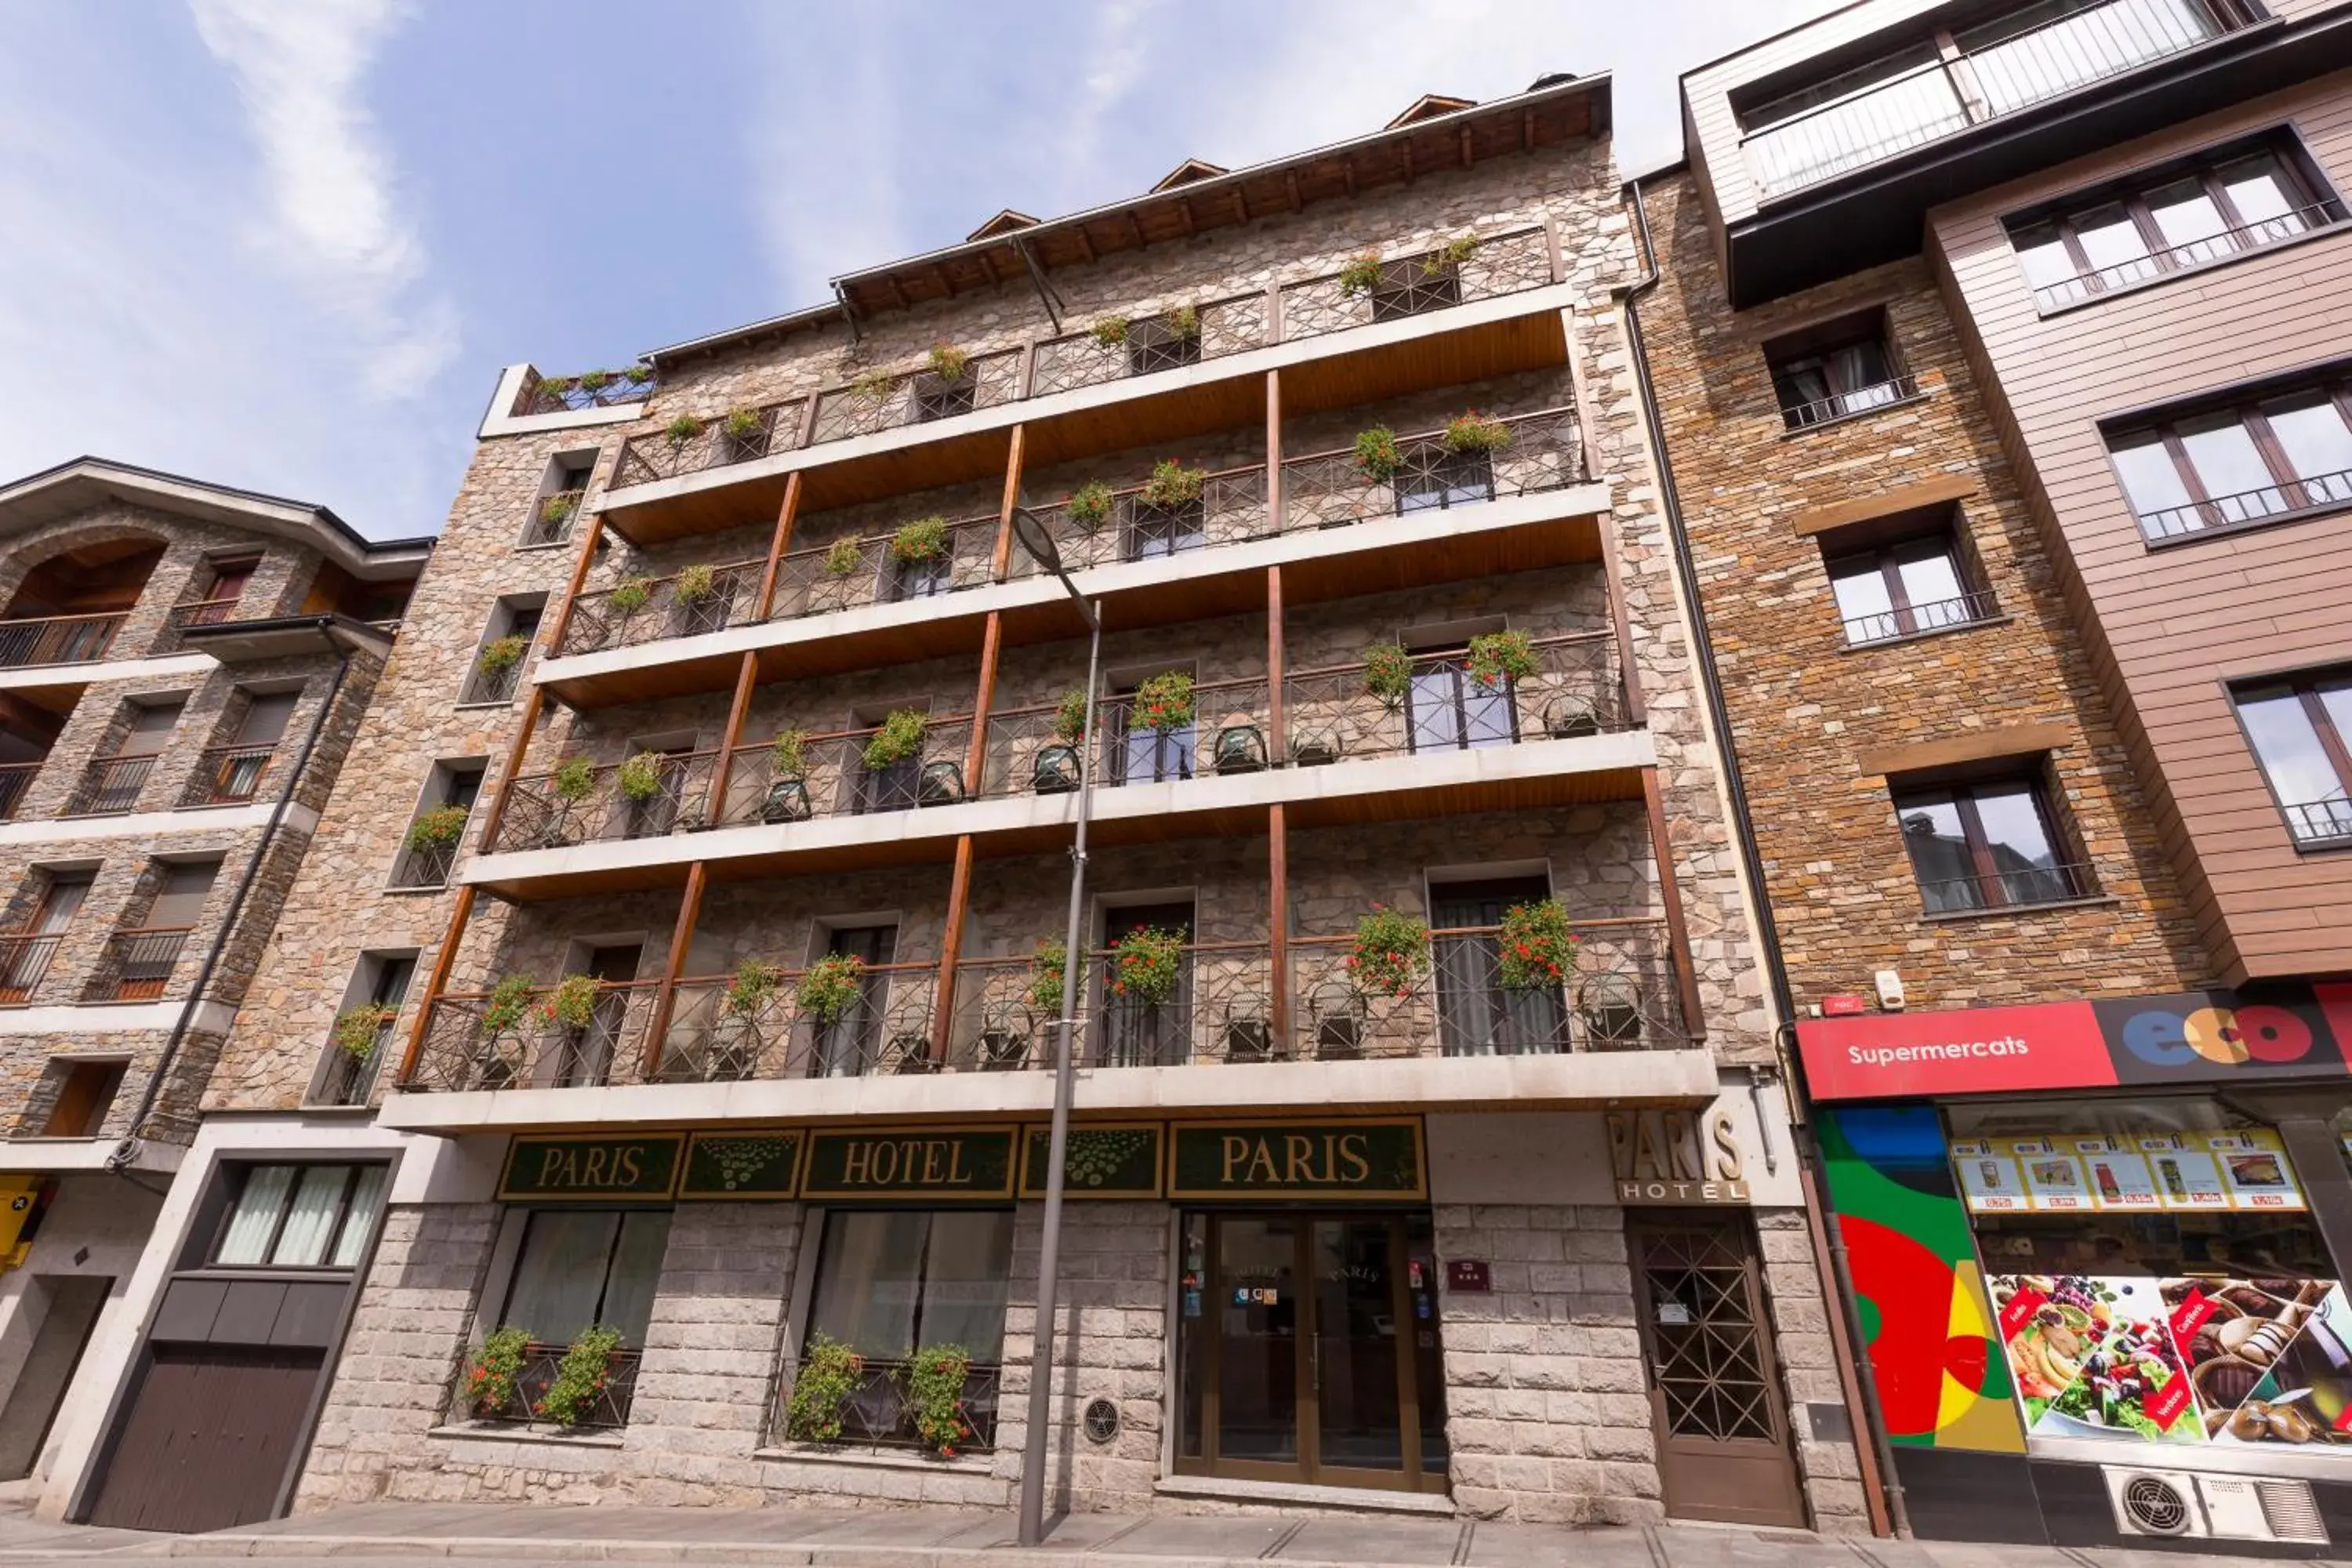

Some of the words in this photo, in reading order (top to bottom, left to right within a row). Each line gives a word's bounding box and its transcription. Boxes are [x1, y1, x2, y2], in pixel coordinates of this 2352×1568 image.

[1848, 1035, 2029, 1066] Supermercats
[2122, 1004, 2314, 1066] eco
[536, 1145, 646, 1187] PARIS
[841, 1141, 972, 1185] HOTEL
[1220, 1134, 1369, 1182] PARIS
[1606, 1109, 1742, 1180] PARIS
[1623, 1184, 1747, 1200] HOTEL
